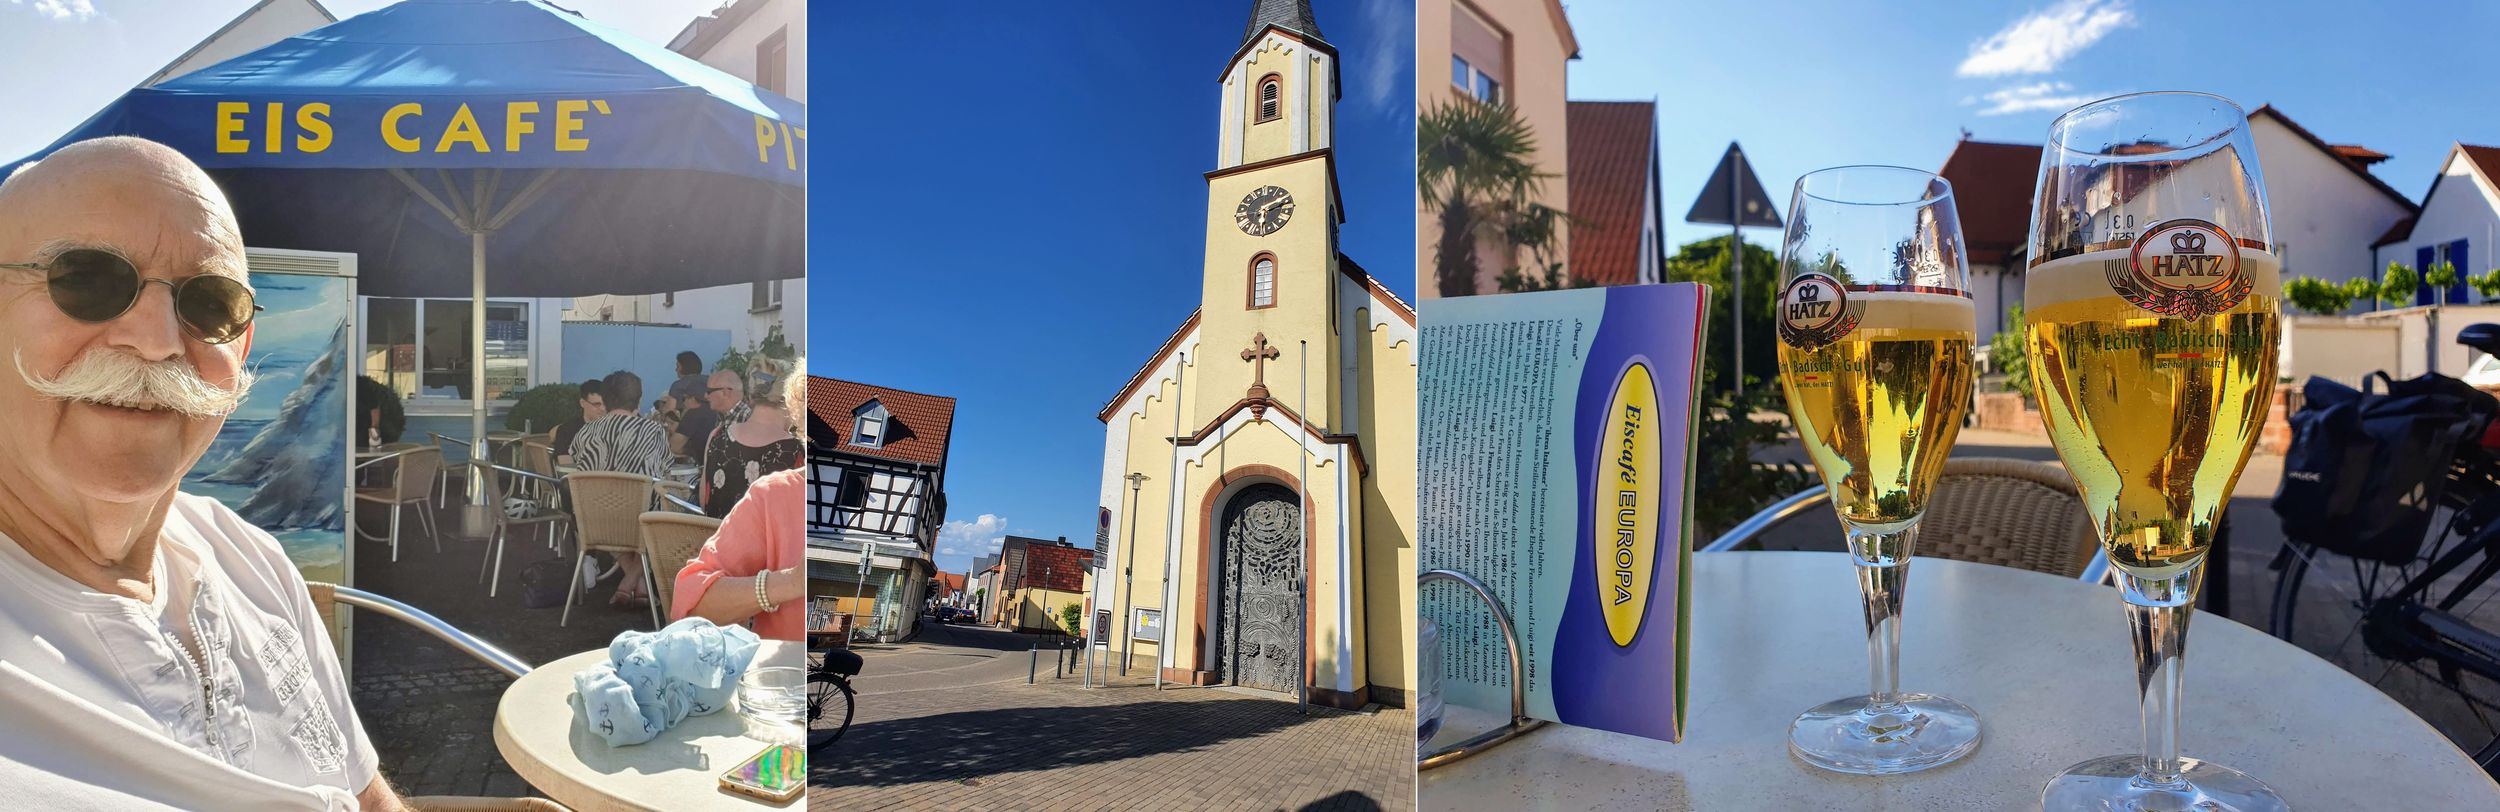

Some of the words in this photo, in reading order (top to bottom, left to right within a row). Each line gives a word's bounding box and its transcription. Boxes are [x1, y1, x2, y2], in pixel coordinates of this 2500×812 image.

[216, 101, 333, 153] EIS
[2152, 255, 2224, 277] HATZ
[1790, 301, 1831, 320] HATZ
[1463, 324, 1472, 344] Doch
[1481, 323, 1490, 342] heute
[1517, 321, 1526, 346] damals
[1525, 321, 1535, 340] Luigi
[1536, 320, 1544, 346] Eiscafé
[1545, 319, 1554, 337] Dies
[1487, 322, 1500, 369] Friedrichsfeld
[1495, 321, 1508, 375] Maximiliansau
[2104, 332, 2140, 350] Echt
[2156, 329, 2224, 349] Badisch
[1460, 345, 1469, 367] immer
[1476, 343, 1487, 381] bekannten
[1514, 348, 1523, 369] schon
[1524, 352, 1532, 363] im
[1531, 347, 1542, 386] EUROPA
[1542, 347, 1550, 367] nicht
[1793, 359, 1833, 373] Badisch
[1458, 368, 1467, 392] wieder
[1468, 363, 1476, 376] Die
[1502, 361, 1510, 399] zusammen
[1513, 372, 1520, 382] im
[1522, 364, 1530, 383] Jahre
[1465, 378, 1474, 404] Familie
[1480, 370, 1494, 420] niedergelassen
[1510, 385, 1519, 412] Bereich
[1520, 385, 1528, 404] 1977
[1456, 393, 1464, 412] hatte
[1470, 381, 1483, 432] Studentenpub
[1546, 398, 1555, 425] kennen
[1452, 412, 1462, 432] Luigi
[1463, 406, 1471, 425] hatte
[1488, 412, 1498, 432] Luigi
[1499, 415, 1507, 436] seiner
[1516, 422, 1525, 447] seinem
[1536, 424, 1543, 433] da
[1461, 443, 1468, 451] in
[1479, 438, 1487, 454] sind
[1488, 434, 1496, 449] und
[1497, 438, 1505, 454] Frau
[1534, 434, 1542, 447] das
[1618, 402, 1642, 489] Eiscafé
[1478, 455, 1485, 465] im
[1496, 456, 1504, 470] den
[1505, 429, 1515, 478] Gastronomie
[1458, 453, 1467, 503] Germersheim
[1486, 451, 1495, 488] Francesca
[1513, 449, 1522, 489] Heimatort
[1532, 461, 1540, 489] Sizilien
[1495, 471, 1503, 497] Schritt
[1502, 480, 1511, 498] tätig
[1466, 486, 1474, 512] betrieb
[1494, 498, 1501, 506] in
[1511, 491, 1519, 524] Raddusa
[1539, 488, 1547, 513] bereits
[1455, 505, 1464, 518] gut
[1530, 490, 1538, 534] stammende
[1465, 528, 1472, 538] ab
[1502, 518, 1509, 528] Im
[1447, 540, 1452, 549] zu
[1454, 519, 1463, 552] eingelebt
[1510, 525, 1518, 548] direkt
[1473, 527, 1481, 578] Germersheim
[1490, 521, 1500, 578] Selbständigkeit
[1527, 535, 1536, 566] Ehepaar
[1615, 490, 1637, 606] EUROPA
[1464, 558, 1471, 566] in
[1473, 612, 1477, 624] wo
[1482, 632, 1489, 640] in
[1526, 622, 1535, 642] Luigi
